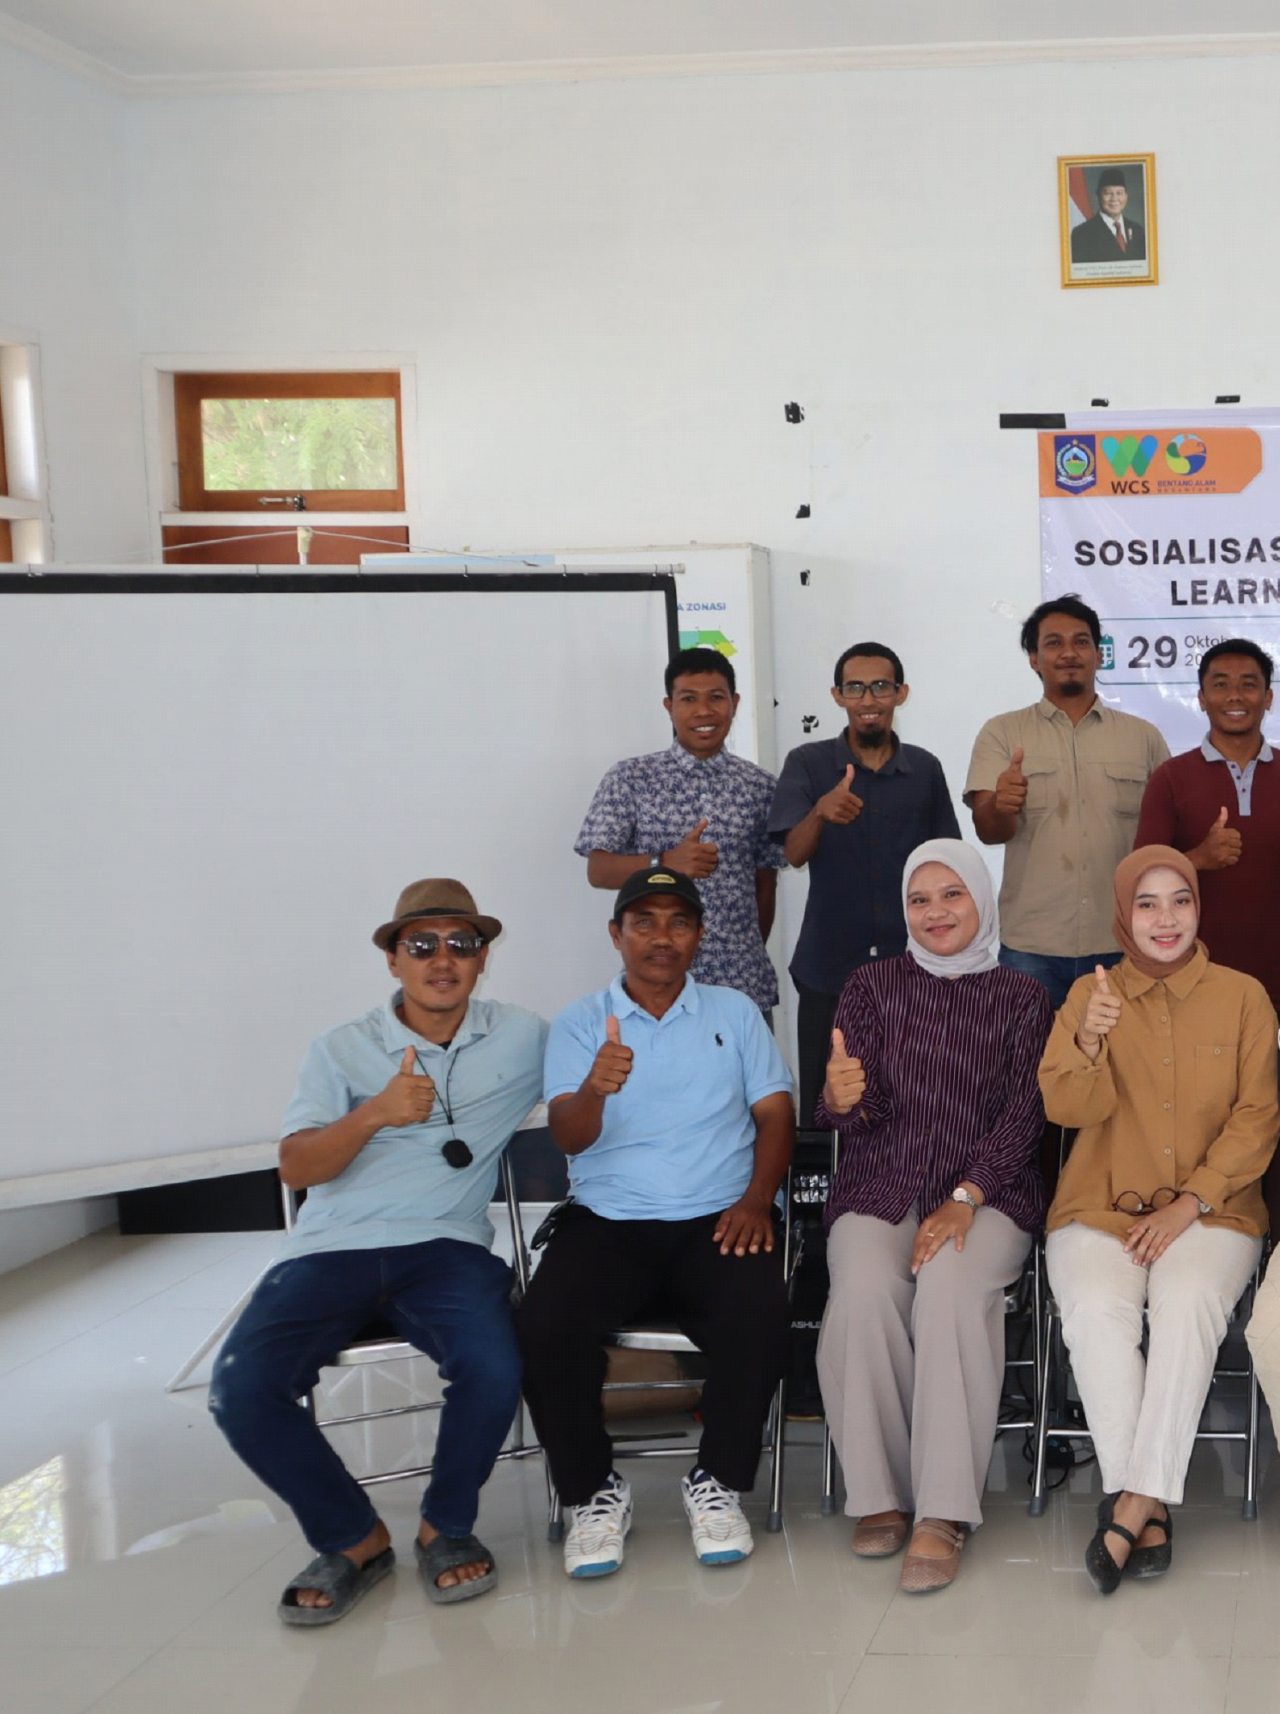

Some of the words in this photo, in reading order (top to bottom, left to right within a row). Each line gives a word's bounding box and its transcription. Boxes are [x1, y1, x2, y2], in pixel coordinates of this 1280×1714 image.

[1111, 480, 1150, 494] WCS
[686, 602, 726, 611] ZONASI
[1184, 634, 1228, 648] Oktob
[1128, 635, 1177, 669] 29
